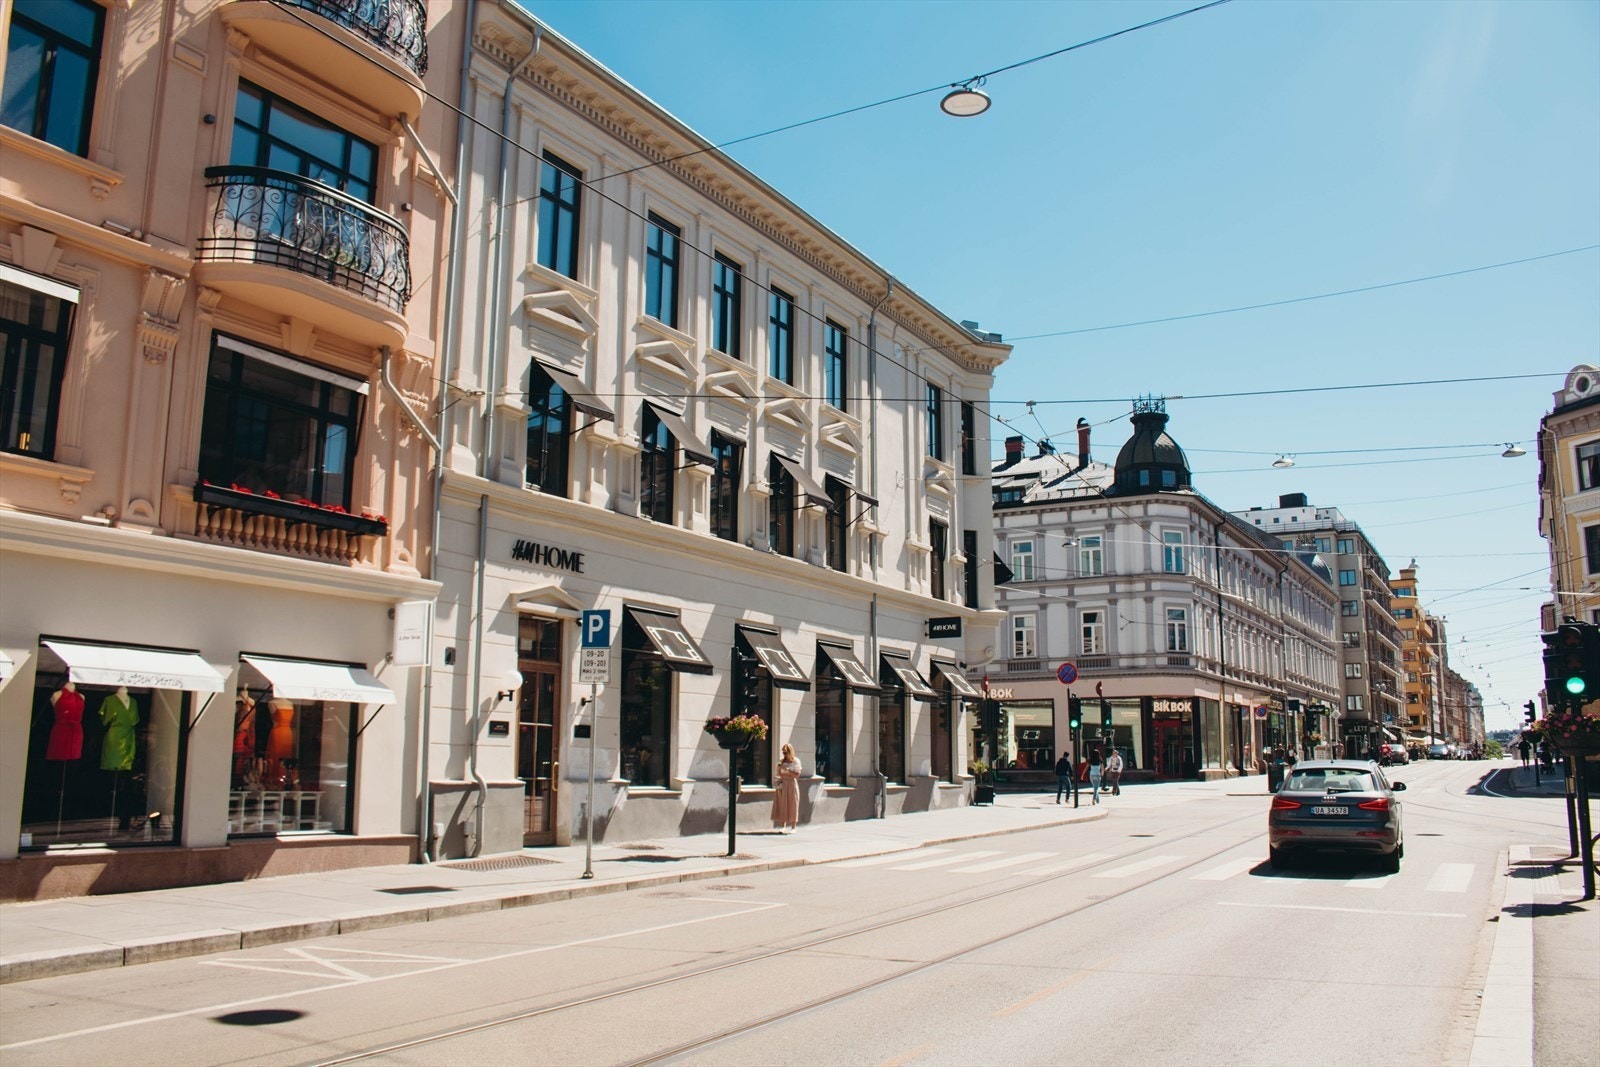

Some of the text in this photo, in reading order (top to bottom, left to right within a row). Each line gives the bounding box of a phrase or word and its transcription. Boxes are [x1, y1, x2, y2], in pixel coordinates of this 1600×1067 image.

[535, 543, 585, 574] HOME
[588, 614, 604, 643] P
[990, 688, 1013, 699] BOK
[1153, 700, 1192, 712] BIK BOK
